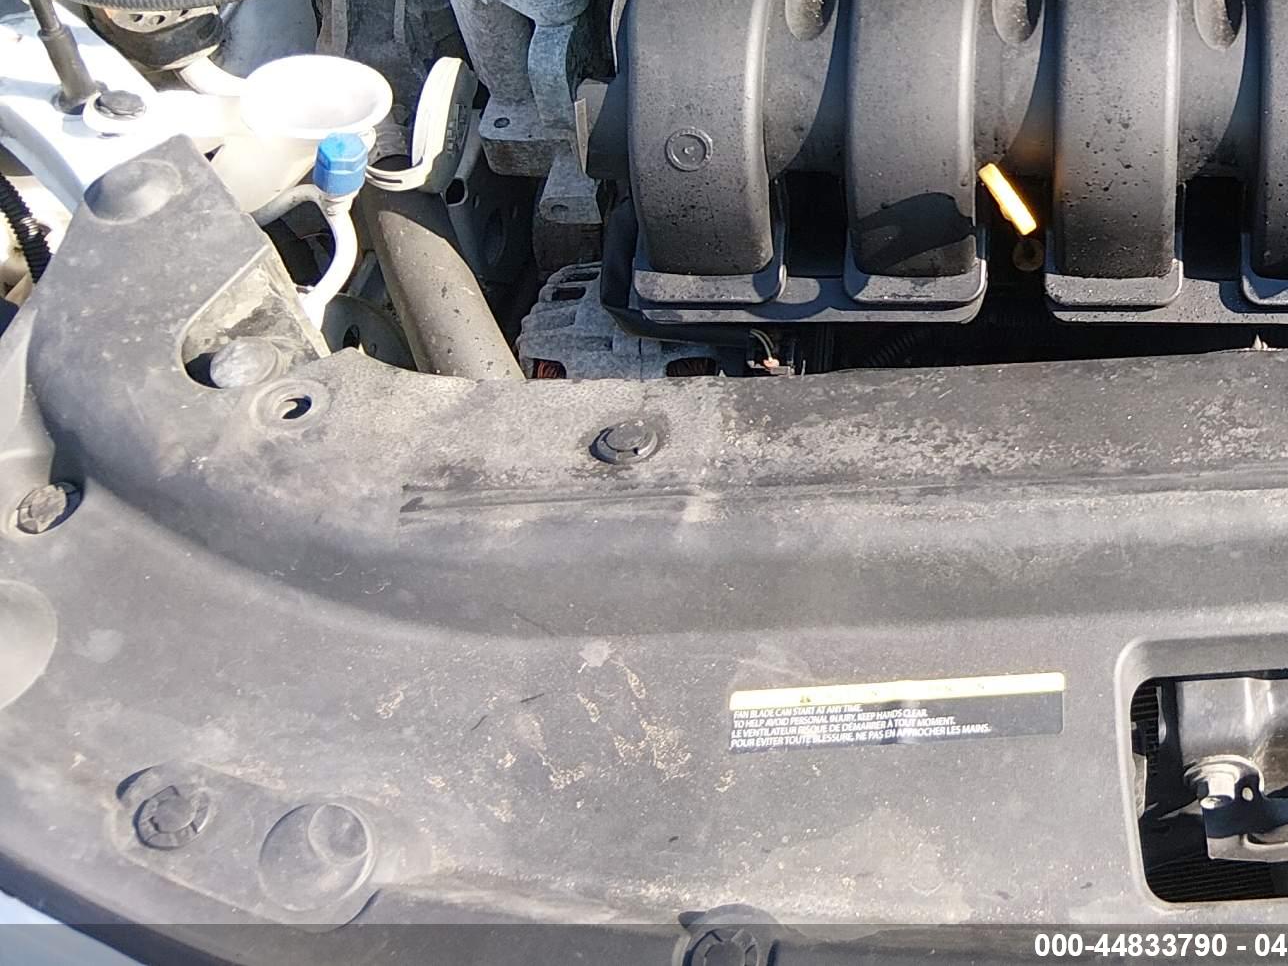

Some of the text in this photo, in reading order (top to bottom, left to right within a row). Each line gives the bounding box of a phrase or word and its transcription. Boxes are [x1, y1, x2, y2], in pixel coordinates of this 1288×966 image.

[734, 710, 749, 719] FAN
[750, 709, 774, 719] BLADE
[775, 707, 792, 717] CAN
[793, 706, 815, 716] START
[816, 705, 826, 714] AT
[826, 704, 842, 714] ANY
[734, 720, 745, 729] TO
[745, 718, 765, 728] HELP
[765, 717, 789, 727] AVOID
[790, 715, 828, 725] PERSONAL
[857, 712, 876, 721] KEEP
[876, 710, 902, 720] HANDS
[731, 729, 742, 738] LE
[743, 726, 797, 737] VENTILATEUR
[798, 724, 829, 734] RISQUE
[829, 723, 840, 732] DE
[894, 717, 916, 727] TOUT
[731, 738, 755, 748] POUR
[784, 735, 812, 746] TOUTE
[855, 730, 867, 741] NE
[868, 730, 884, 740] PAS
[885, 728, 896, 738] EN
[897, 726, 945, 737] APPROCHER
[946, 725, 961, 735] LES
